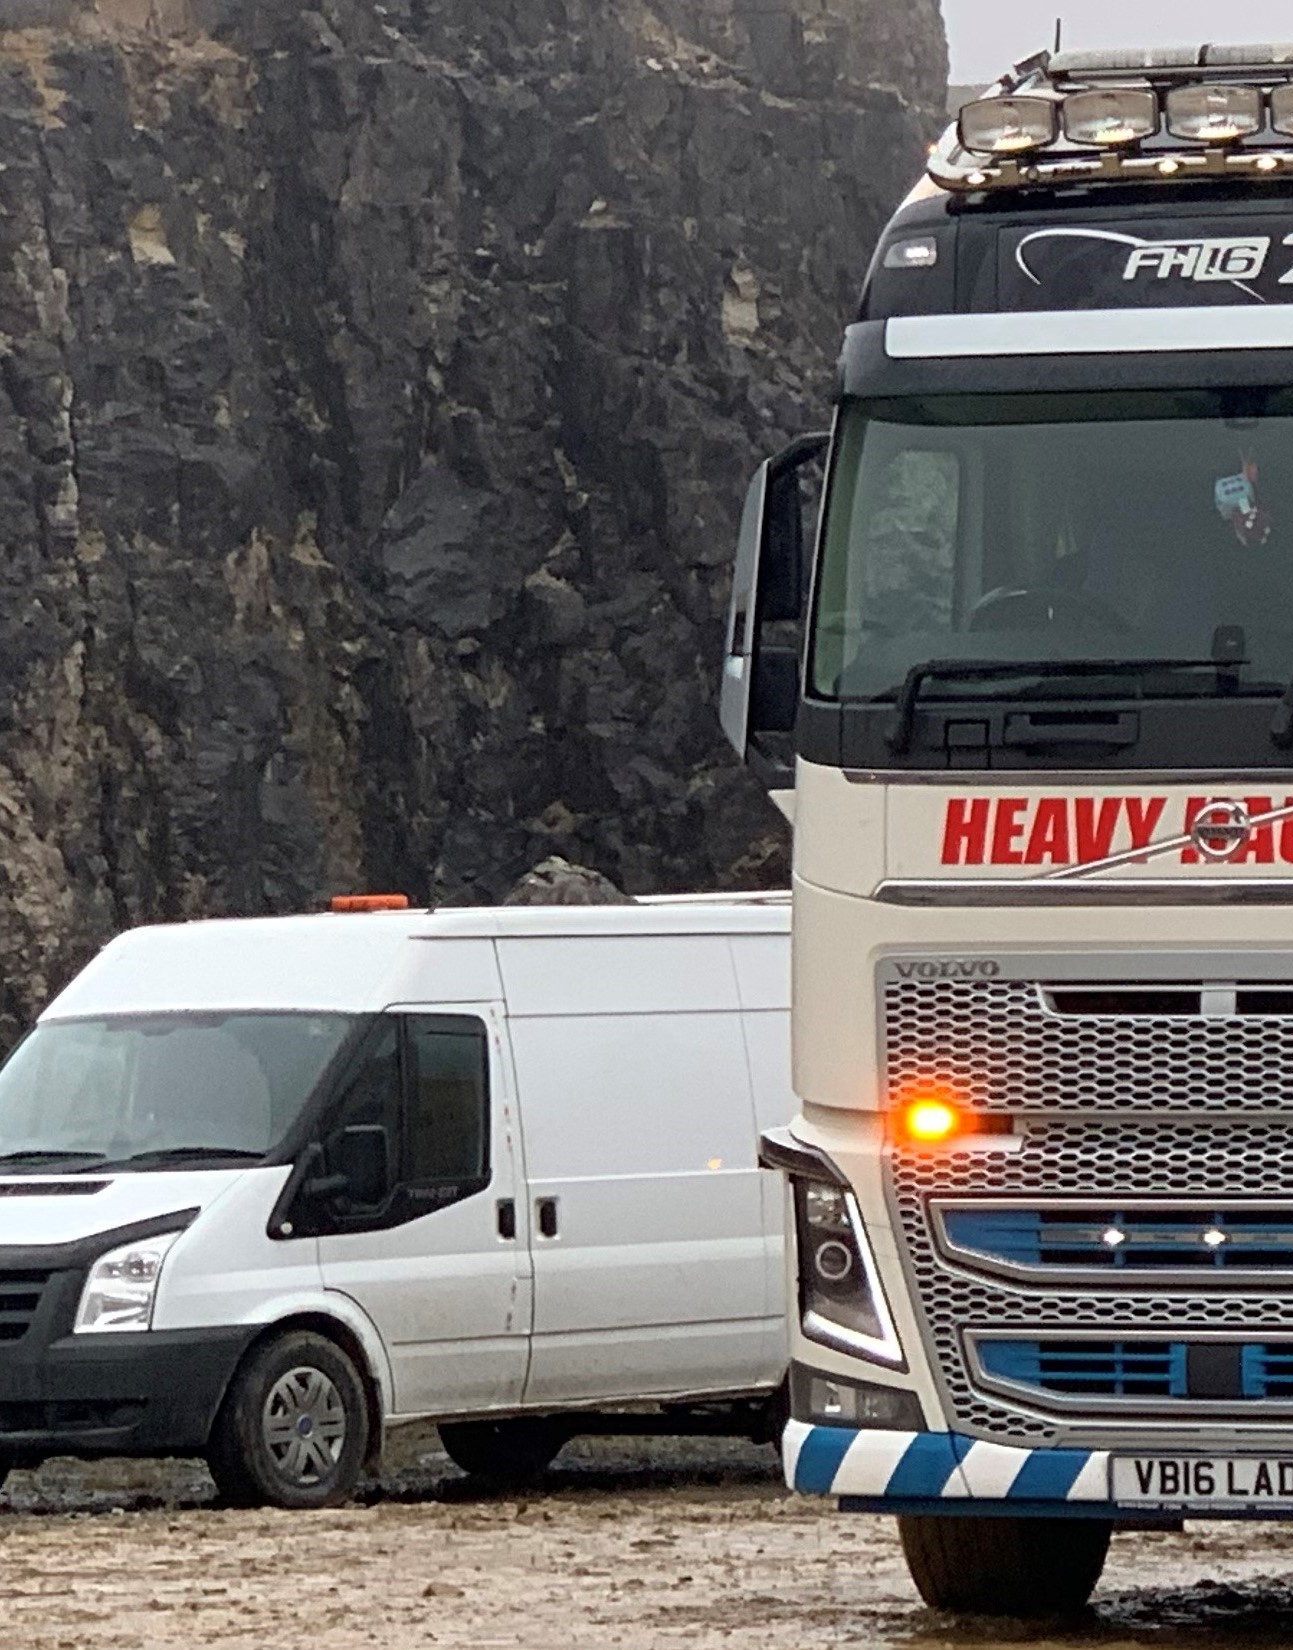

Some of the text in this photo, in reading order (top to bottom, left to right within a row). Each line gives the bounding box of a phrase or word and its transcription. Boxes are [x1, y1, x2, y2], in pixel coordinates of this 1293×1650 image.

[940, 796, 1168, 865] HEAVY
[893, 960, 1000, 978] VOLVO
[1134, 1459, 1215, 1496] VB16
